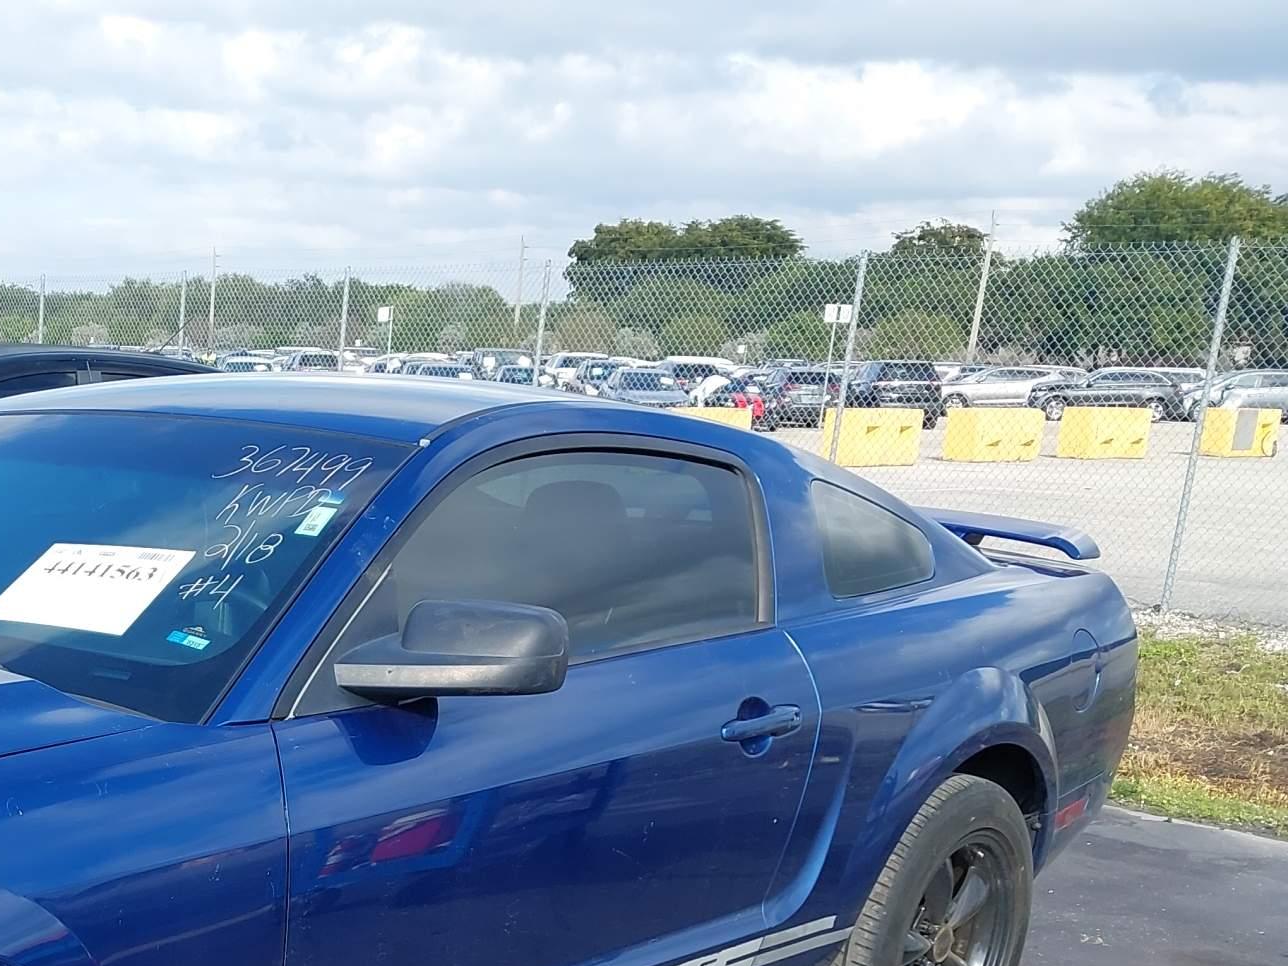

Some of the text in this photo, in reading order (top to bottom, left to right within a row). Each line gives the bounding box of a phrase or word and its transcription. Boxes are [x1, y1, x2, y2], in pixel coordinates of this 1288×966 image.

[211, 445, 375, 491] 367499
[204, 519, 284, 571] 2/18
[43, 560, 158, 582] 44141563
[178, 573, 244, 610] #4
